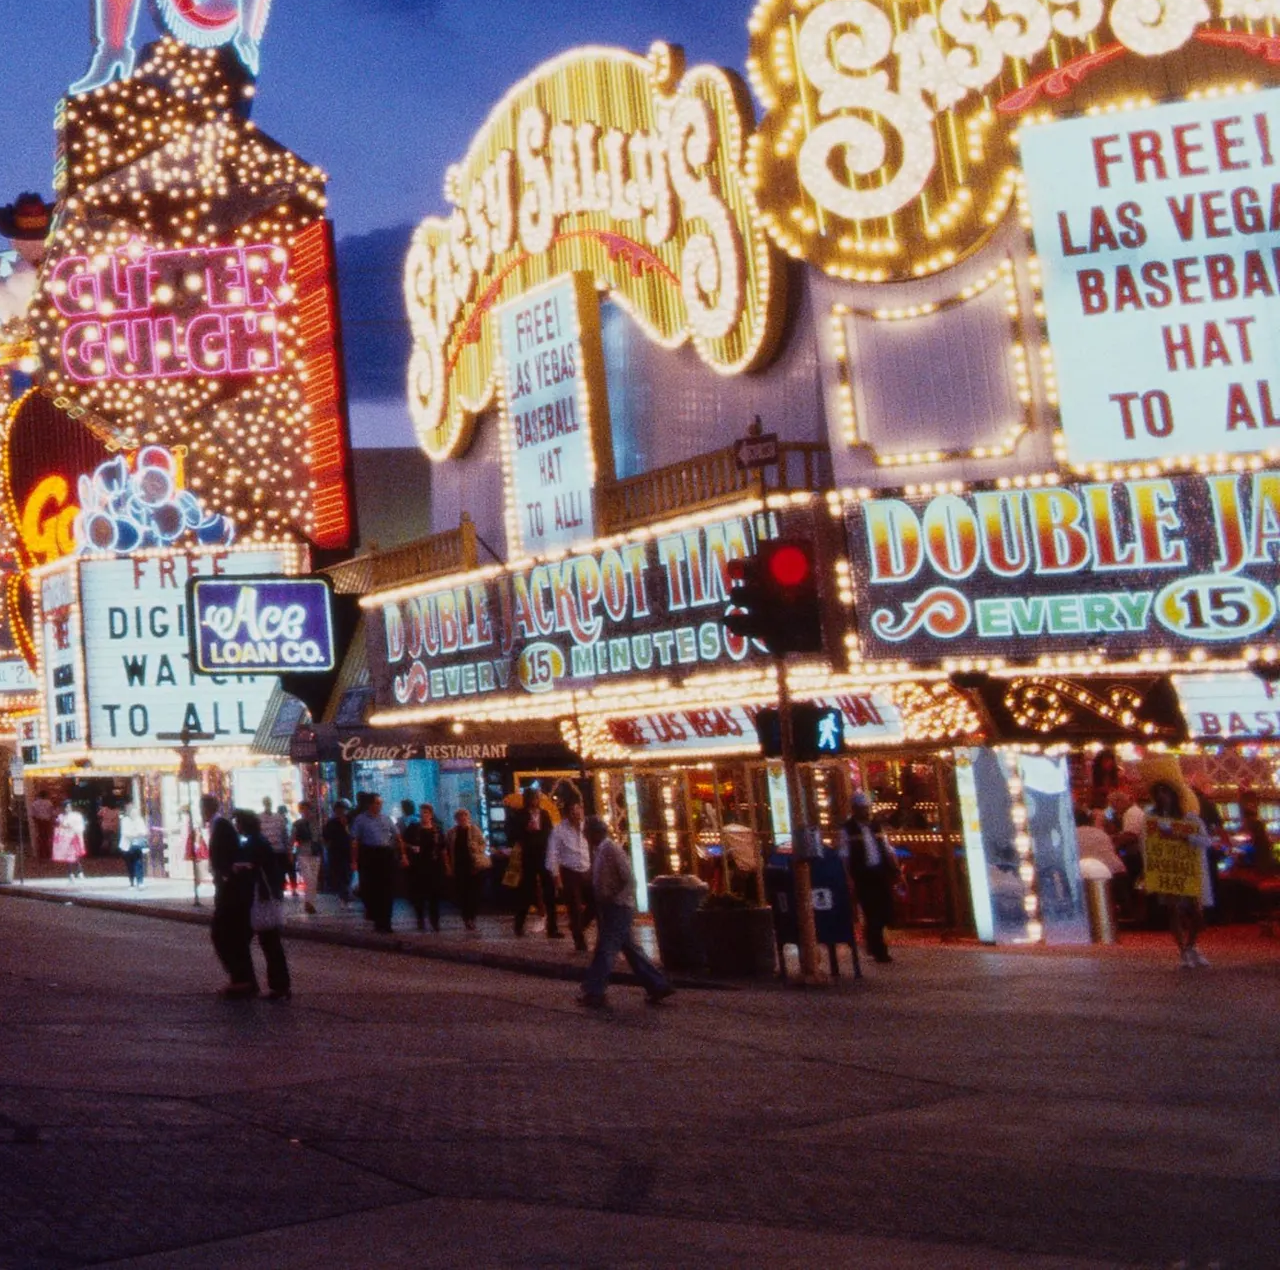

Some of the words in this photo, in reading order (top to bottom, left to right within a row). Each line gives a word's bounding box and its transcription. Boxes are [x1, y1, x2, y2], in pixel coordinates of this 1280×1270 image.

[1091, 112, 1274, 189] FREE!
[1057, 201, 1148, 257] LAS
[51, 241, 288, 317] GLITTER
[1076, 247, 1280, 317] BASEBA
[62, 311, 280, 382] GULCH
[1160, 315, 1256, 373] HAT
[514, 394, 580, 450] BASEBALL
[1108, 388, 1175, 441] TO
[539, 446, 563, 486] HAT
[526, 502, 544, 539] TO
[863, 477, 1188, 584] DOUBLE
[132, 552, 230, 590] FREE
[203, 586, 307, 641] Ace
[383, 581, 494, 663] DOUBLE
[497, 542, 650, 656] JACKPOT
[975, 593, 1154, 638] EVERY
[1179, 587, 1253, 627] 15
[209, 641, 278, 664] LOAN
[281, 640, 326, 664] CO.
[430, 659, 512, 699] EVERY
[526, 650, 551, 686] 15
[570, 621, 721, 678] MINUTES
[101, 703, 150, 738] TO
[183, 700, 258, 736] ALL
[424, 742, 509, 760] RESTAURANT
